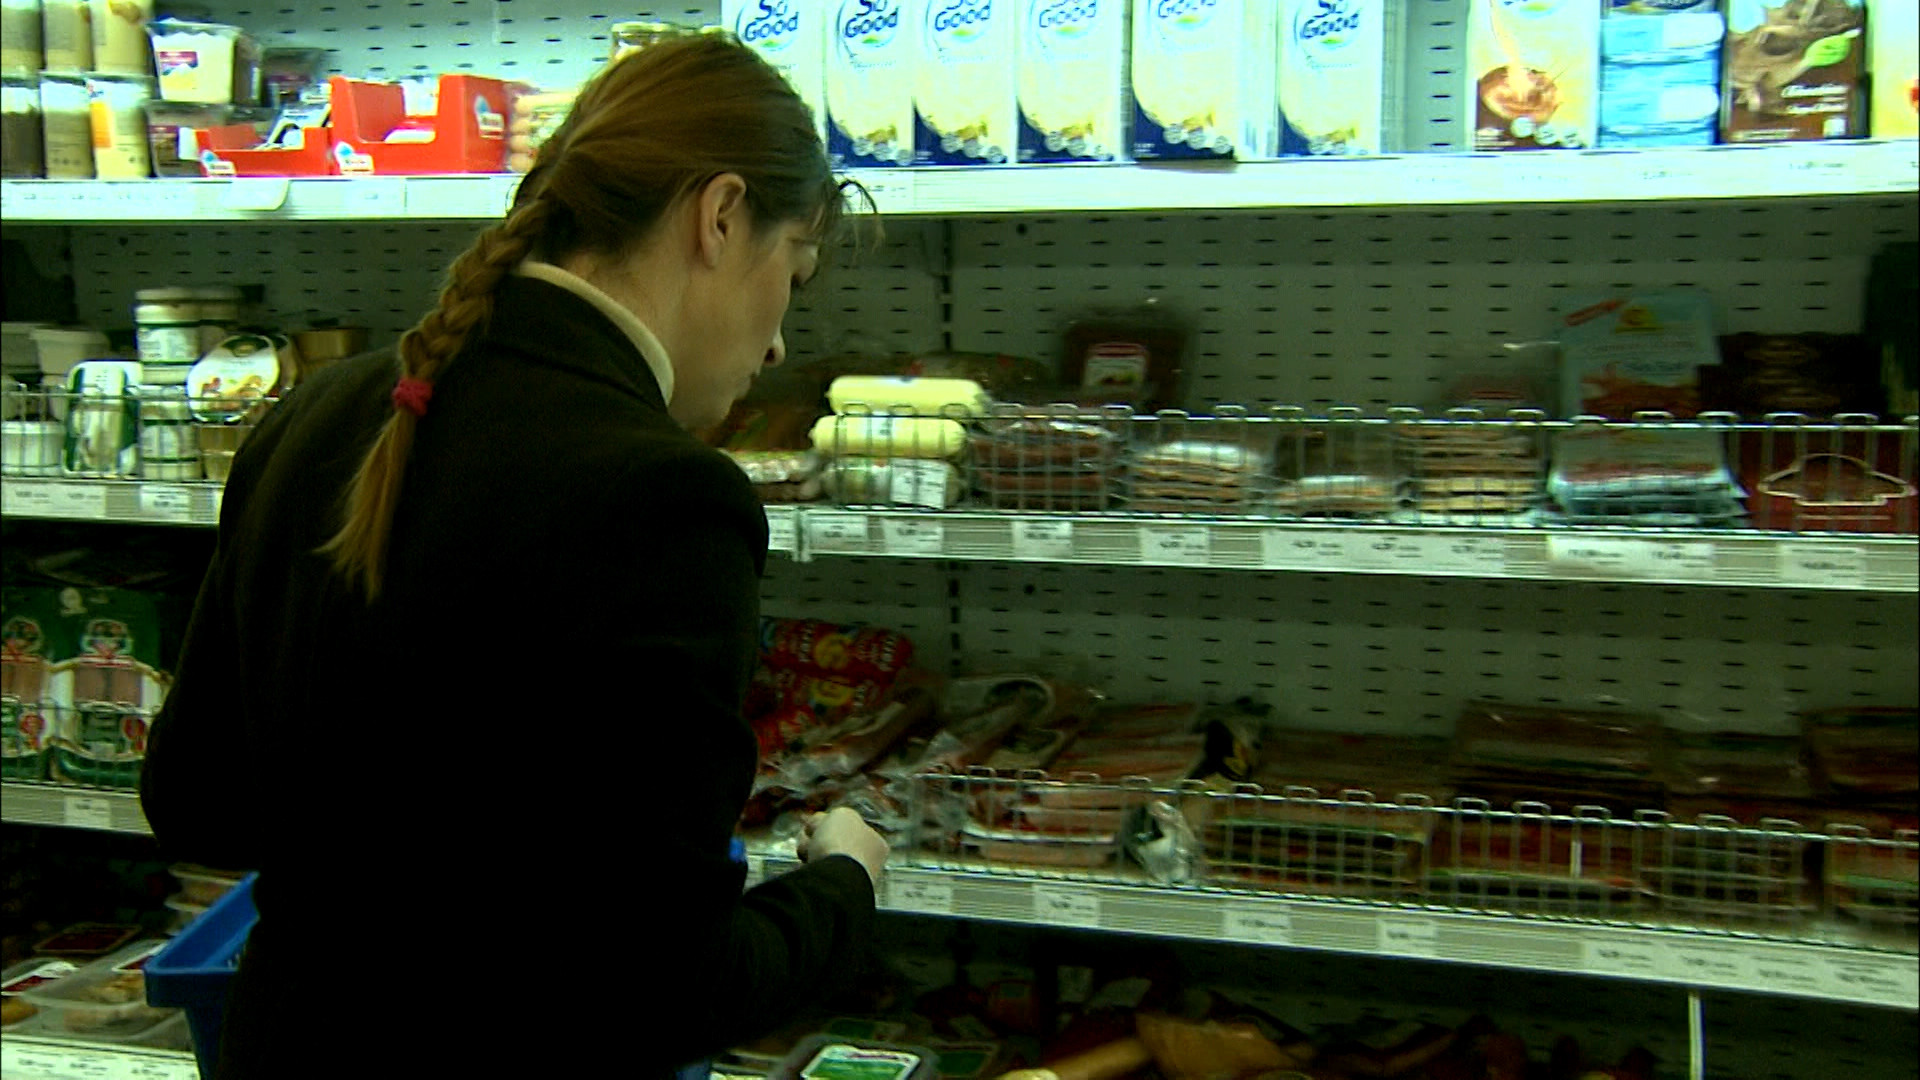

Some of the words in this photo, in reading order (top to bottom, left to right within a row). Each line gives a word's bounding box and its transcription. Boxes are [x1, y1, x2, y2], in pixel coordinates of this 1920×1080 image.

[744, 11, 798, 42] Good
[845, 6, 899, 38] Good
[936, 0, 992, 31] Good
[1301, 9, 1361, 39] Good
